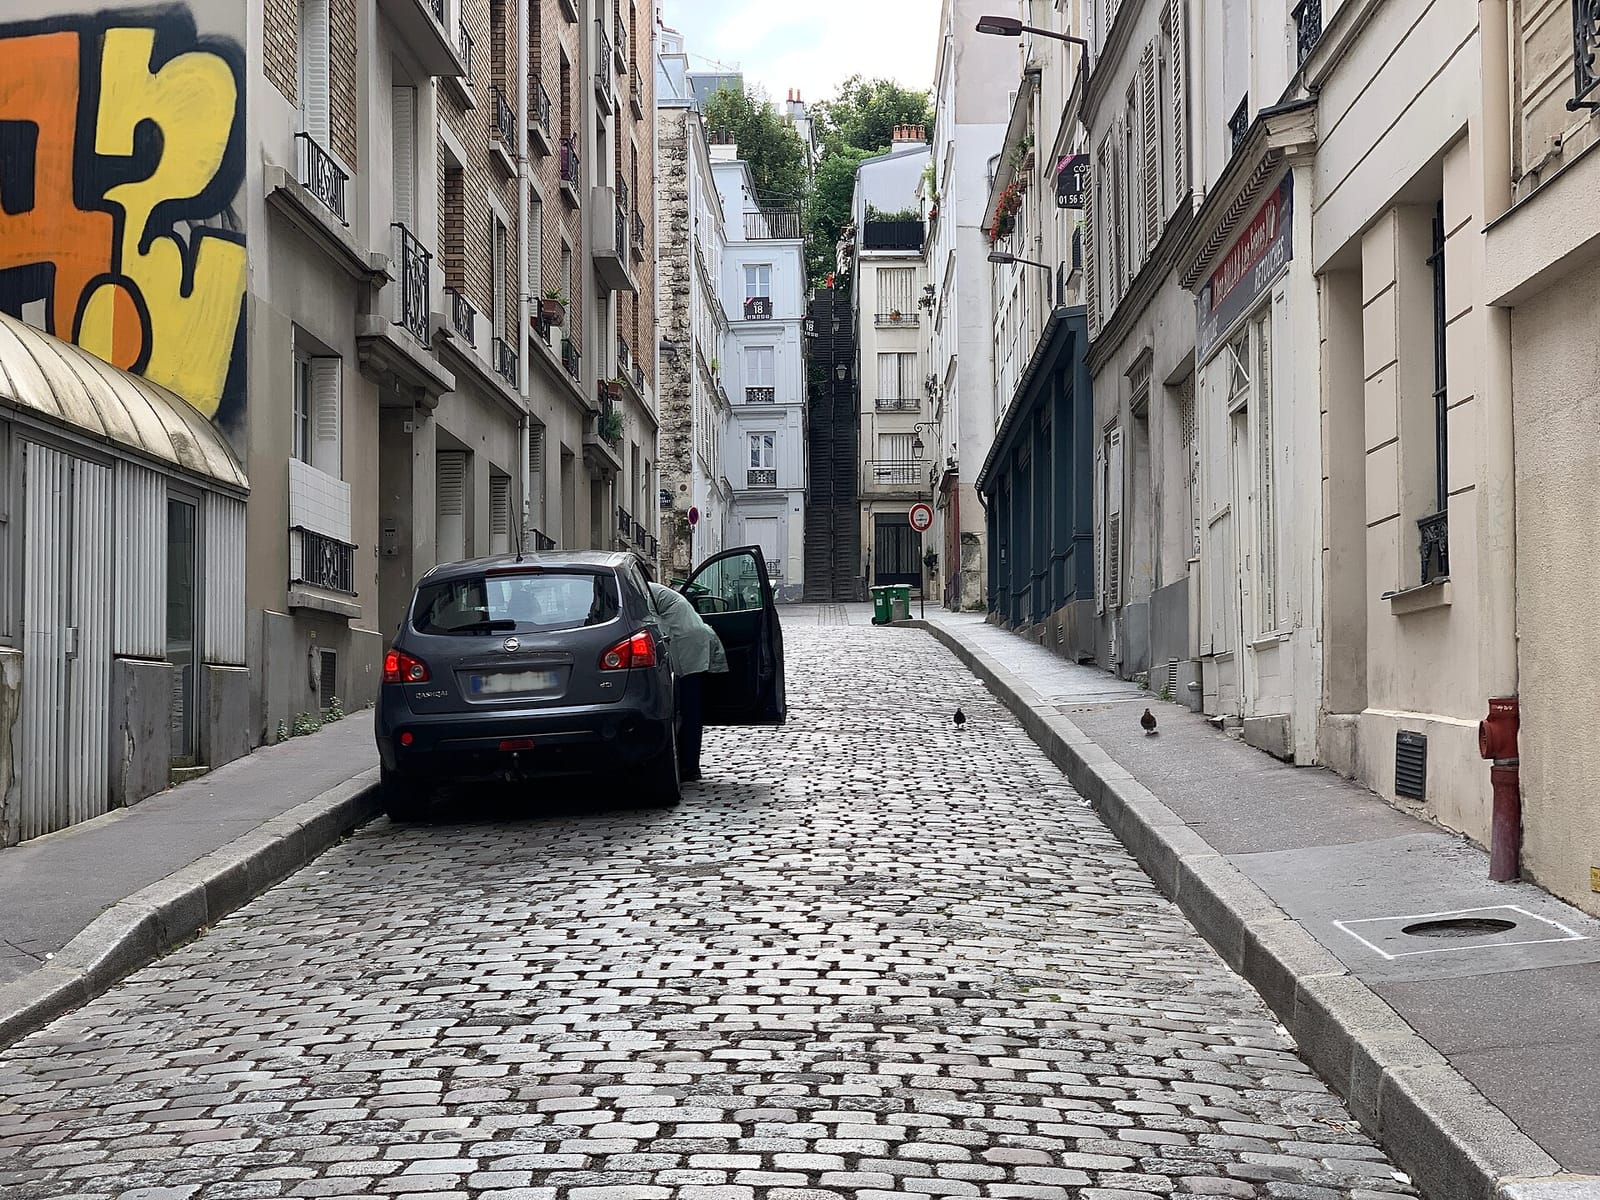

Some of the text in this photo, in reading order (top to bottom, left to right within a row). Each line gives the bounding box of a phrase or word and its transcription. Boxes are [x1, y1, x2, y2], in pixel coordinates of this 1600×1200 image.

[1073, 163, 1090, 173] CÔT
[1059, 195, 1067, 204] 01
[1069, 194, 1078, 204] 56
[754, 305, 763, 314] 18
[805, 323, 814, 332] 18
